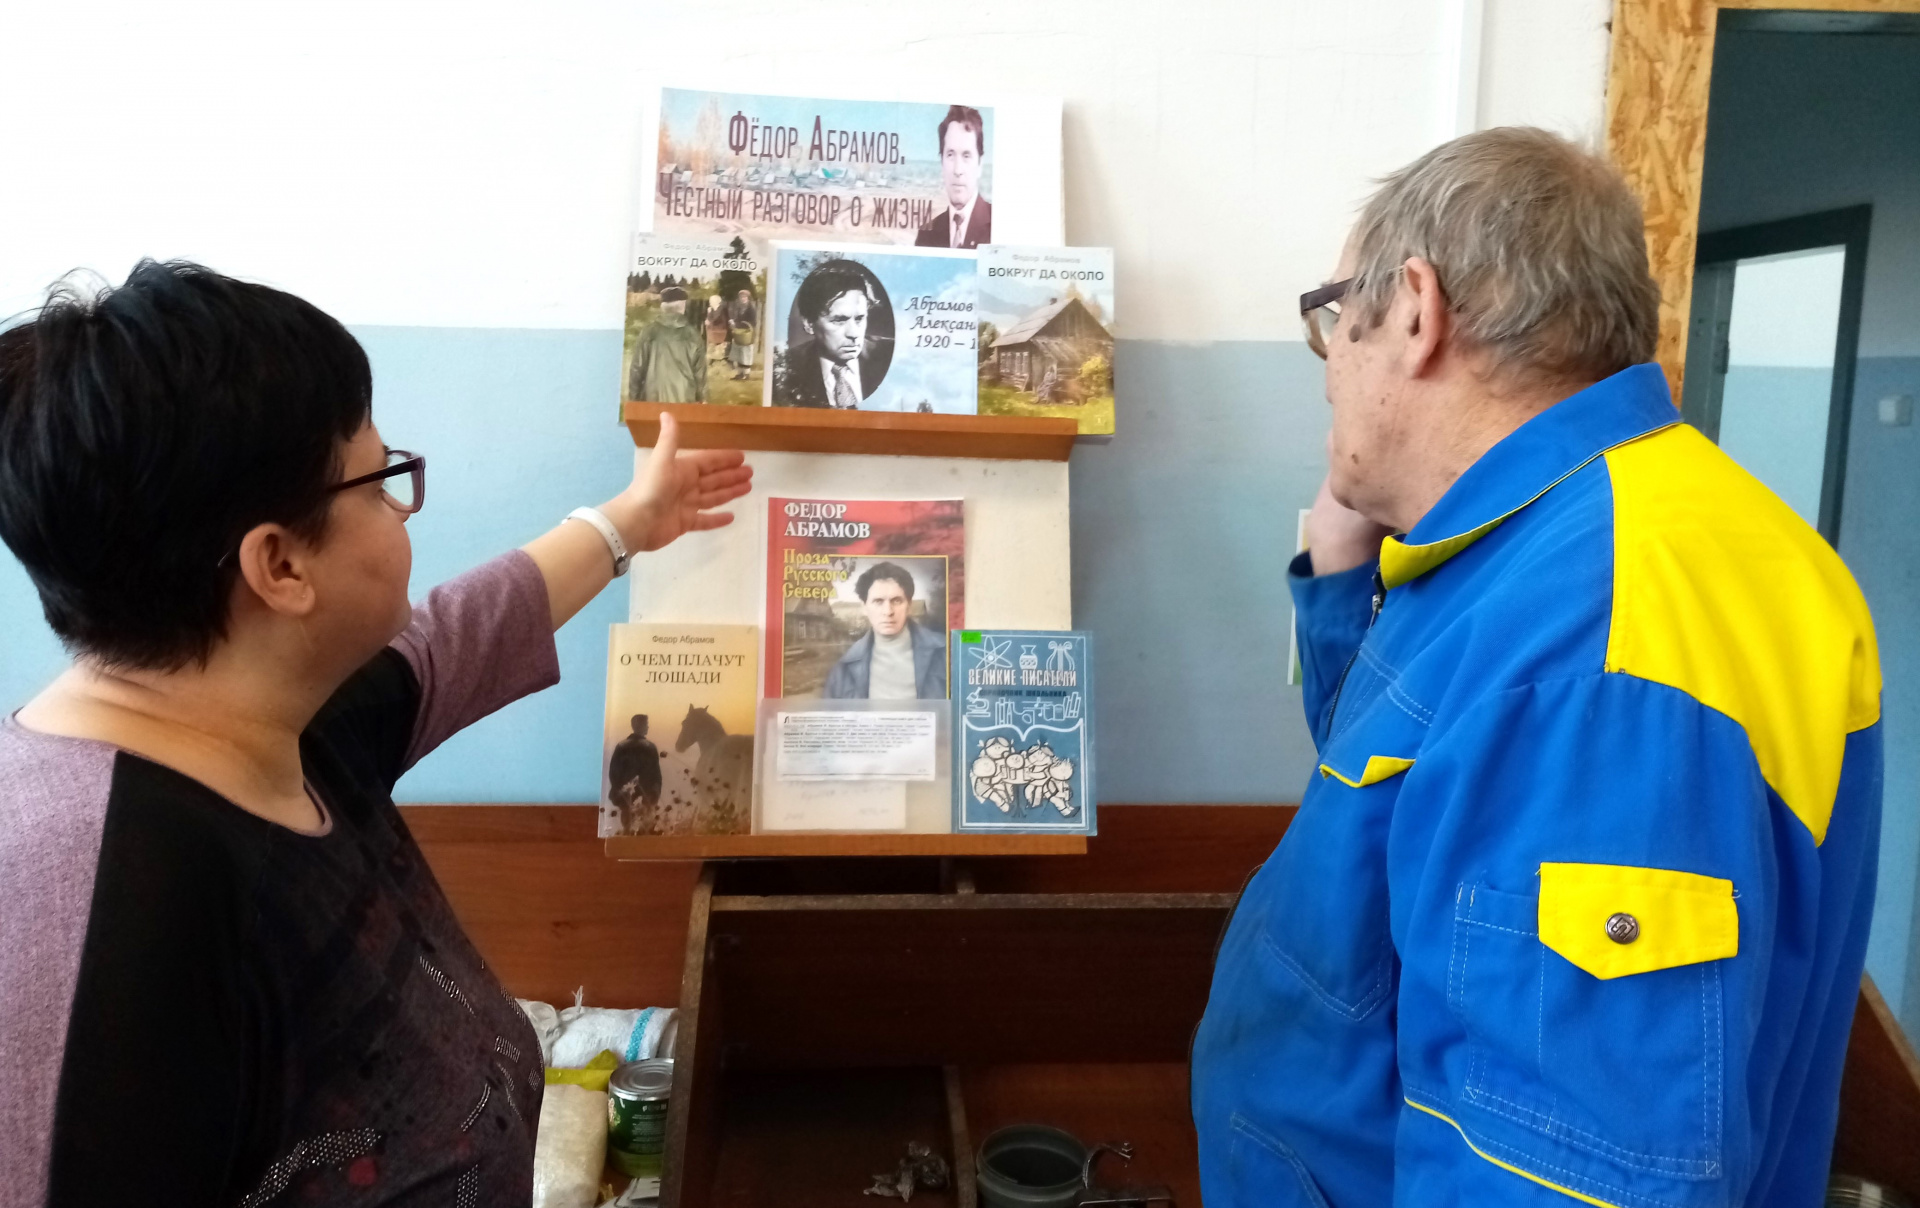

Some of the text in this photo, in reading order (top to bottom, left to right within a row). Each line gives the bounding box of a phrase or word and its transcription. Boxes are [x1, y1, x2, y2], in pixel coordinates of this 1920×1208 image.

[729, 110, 798, 163] ФЁДОР
[659, 172, 934, 230] ЧЕСТНЫЙ РАЗГОВОР О ЖИЗНИ
[638, 256, 757, 271] ВОКРУГ ДА ОКОЛО
[988, 267, 1104, 281] ВОКРУГ ДА ОКОЛО
[904, 295, 973, 315] Абрамов
[914, 334, 950, 349] 1920
[784, 502, 847, 521] ФЕДОР
[784, 521, 870, 539] АБРАМОВ
[783, 548, 830, 568] Проза
[783, 565, 848, 586] Русского
[782, 582, 837, 603] Севера
[652, 635, 715, 644] Федор Абрамов
[620, 653, 745, 667] О ЧЕМ ПЛАЧУТ
[645, 671, 721, 685] ЛОШАДИ
[968, 668, 1077, 687] ВЕЛИКИЕ ПИСАТЕЛИ
